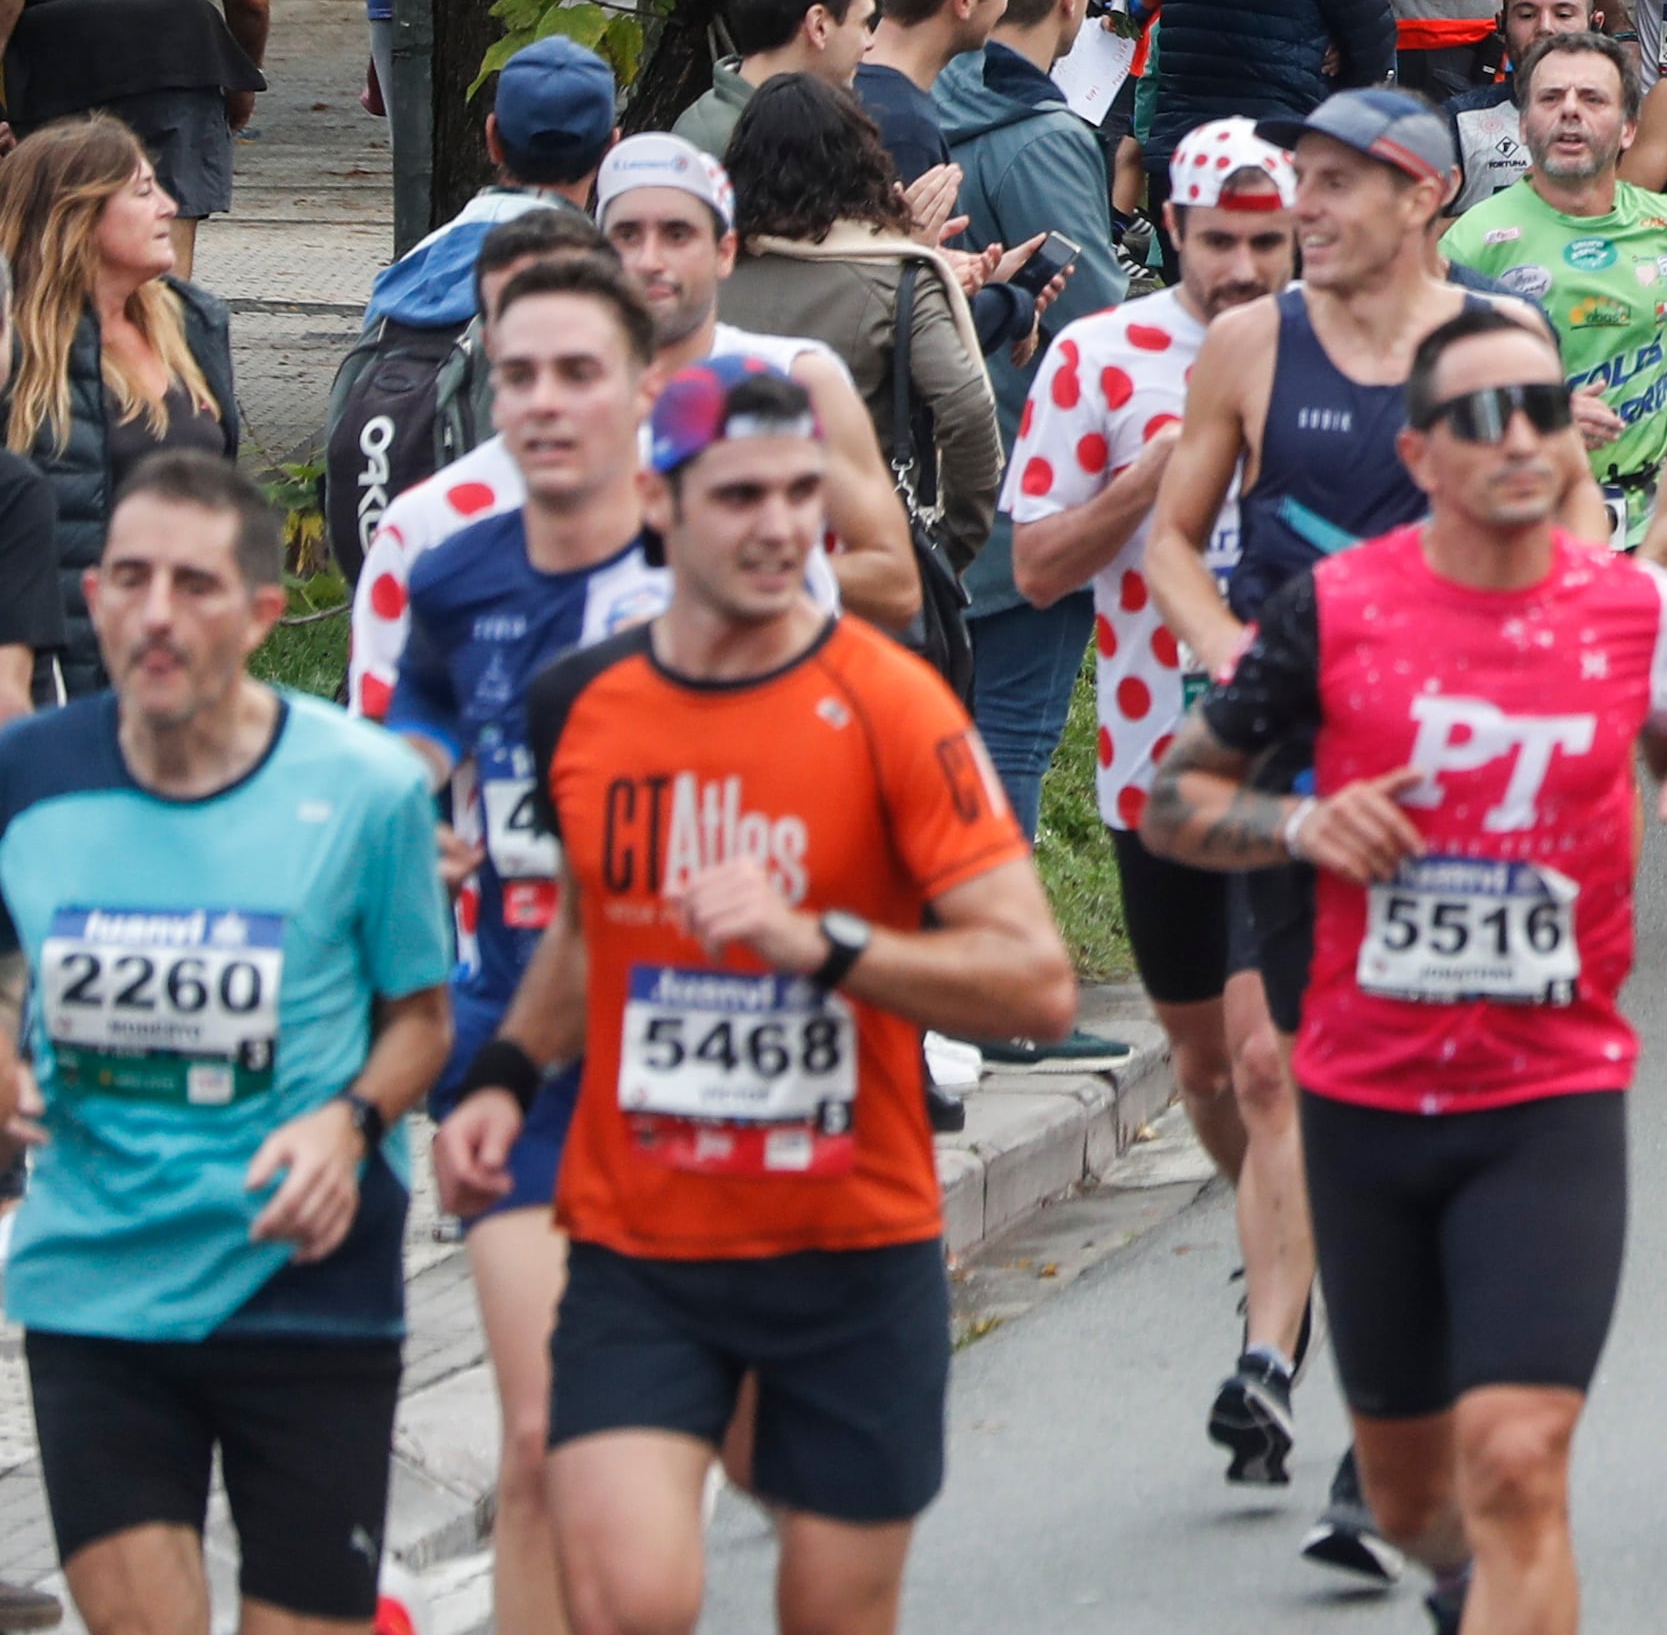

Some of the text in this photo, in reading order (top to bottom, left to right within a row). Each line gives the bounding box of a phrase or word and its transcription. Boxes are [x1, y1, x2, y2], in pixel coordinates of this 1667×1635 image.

[1395, 693, 1597, 832] PT
[1381, 899, 1564, 955] 5516
[60, 952, 263, 1013] 2260
[643, 1017, 843, 1079] 5468
